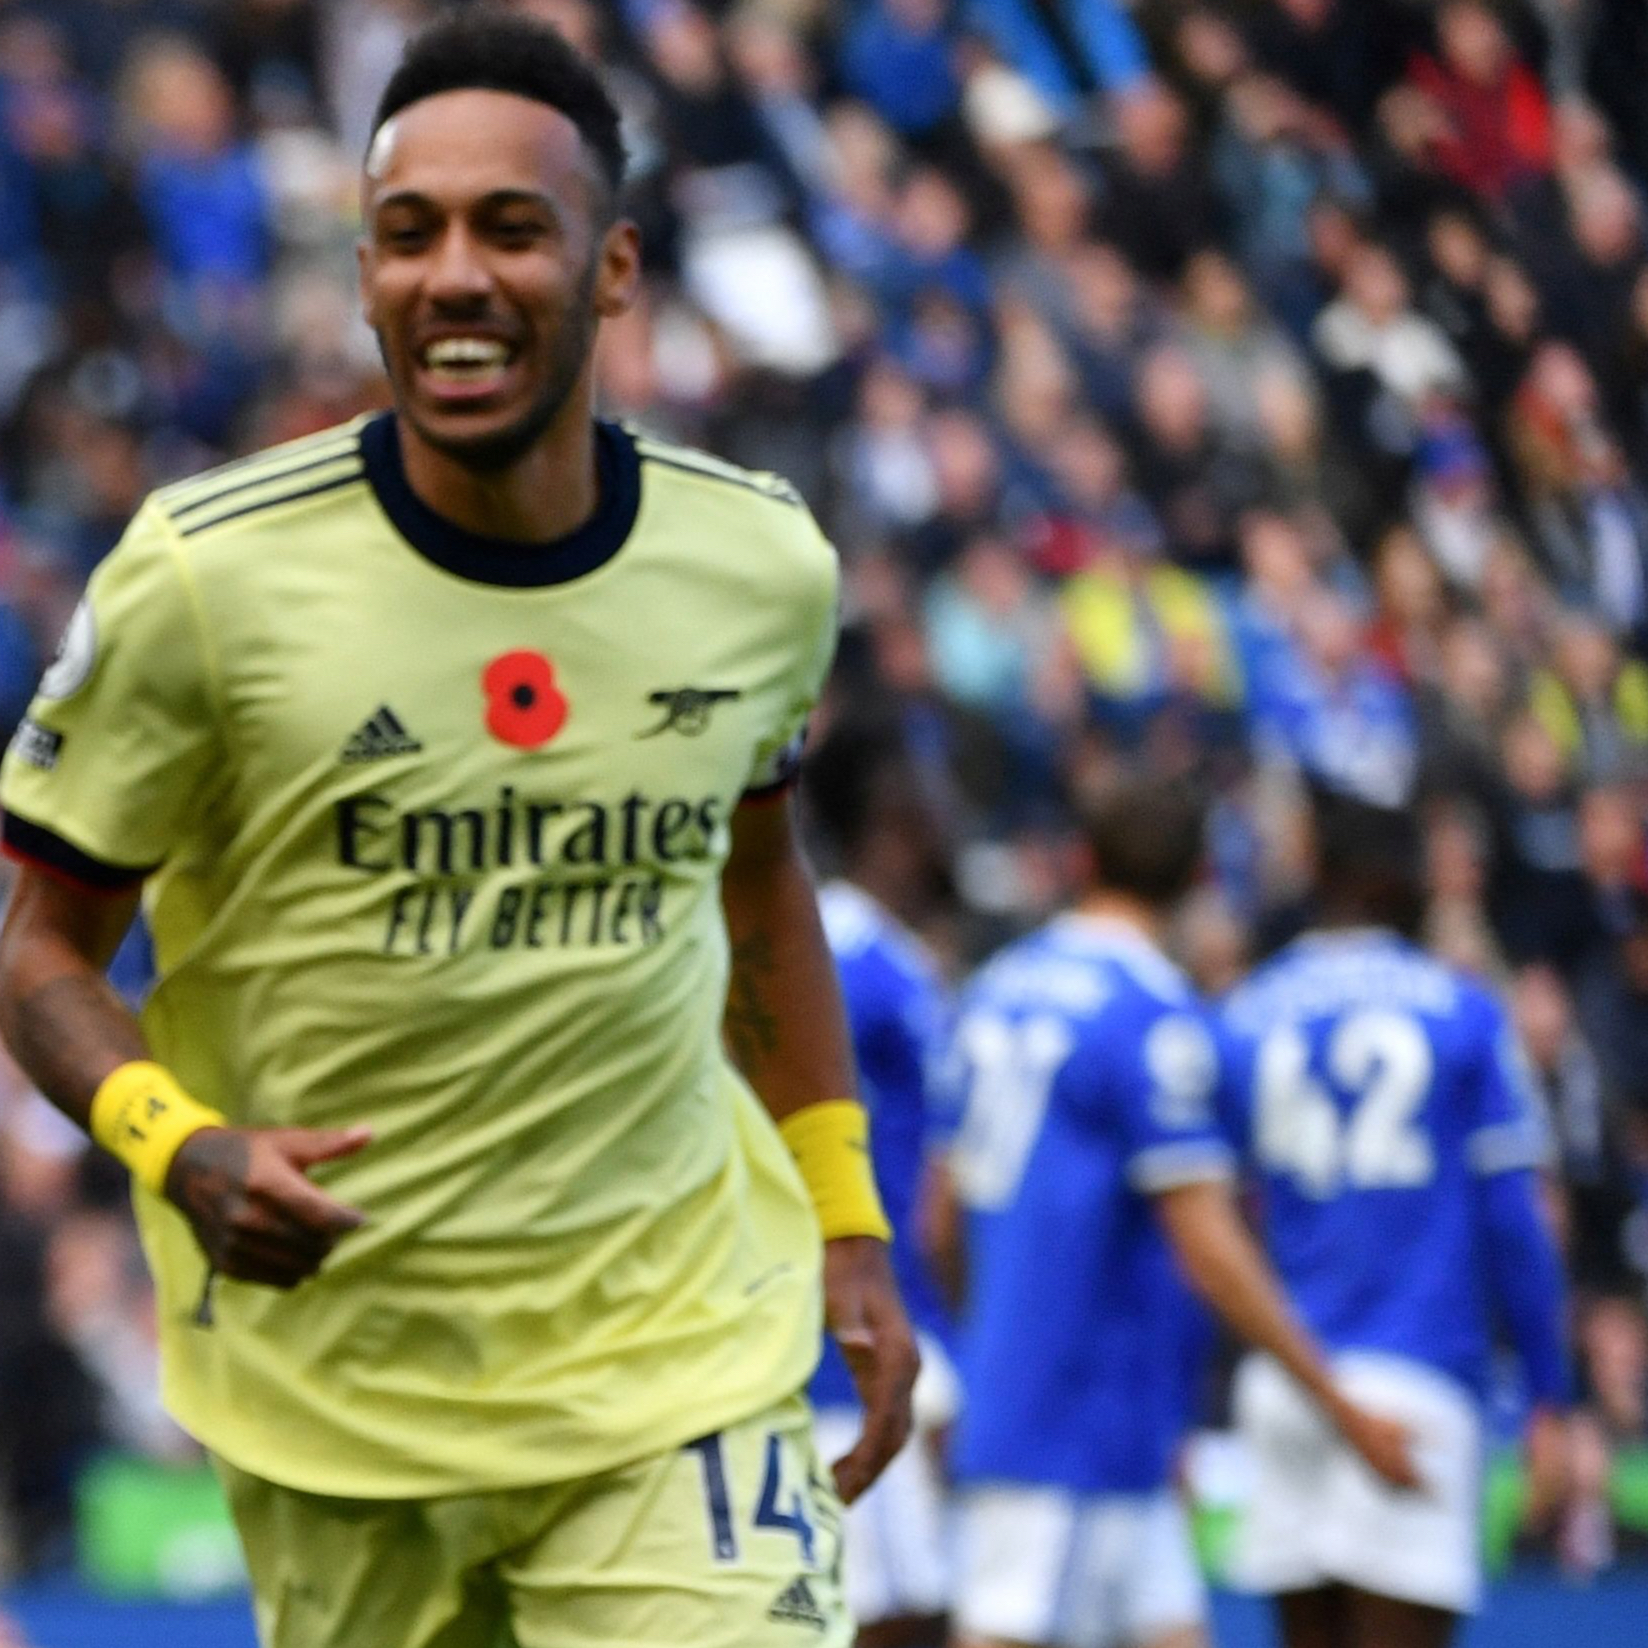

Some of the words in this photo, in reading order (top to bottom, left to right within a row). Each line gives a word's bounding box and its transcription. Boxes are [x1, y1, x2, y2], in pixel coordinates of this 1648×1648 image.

[334, 784, 724, 873] Emirates
[383, 883, 474, 955] FLY
[488, 876, 668, 950] BETTER
[1251, 1005, 1435, 1200] 42
[680, 1430, 816, 1564] 14
